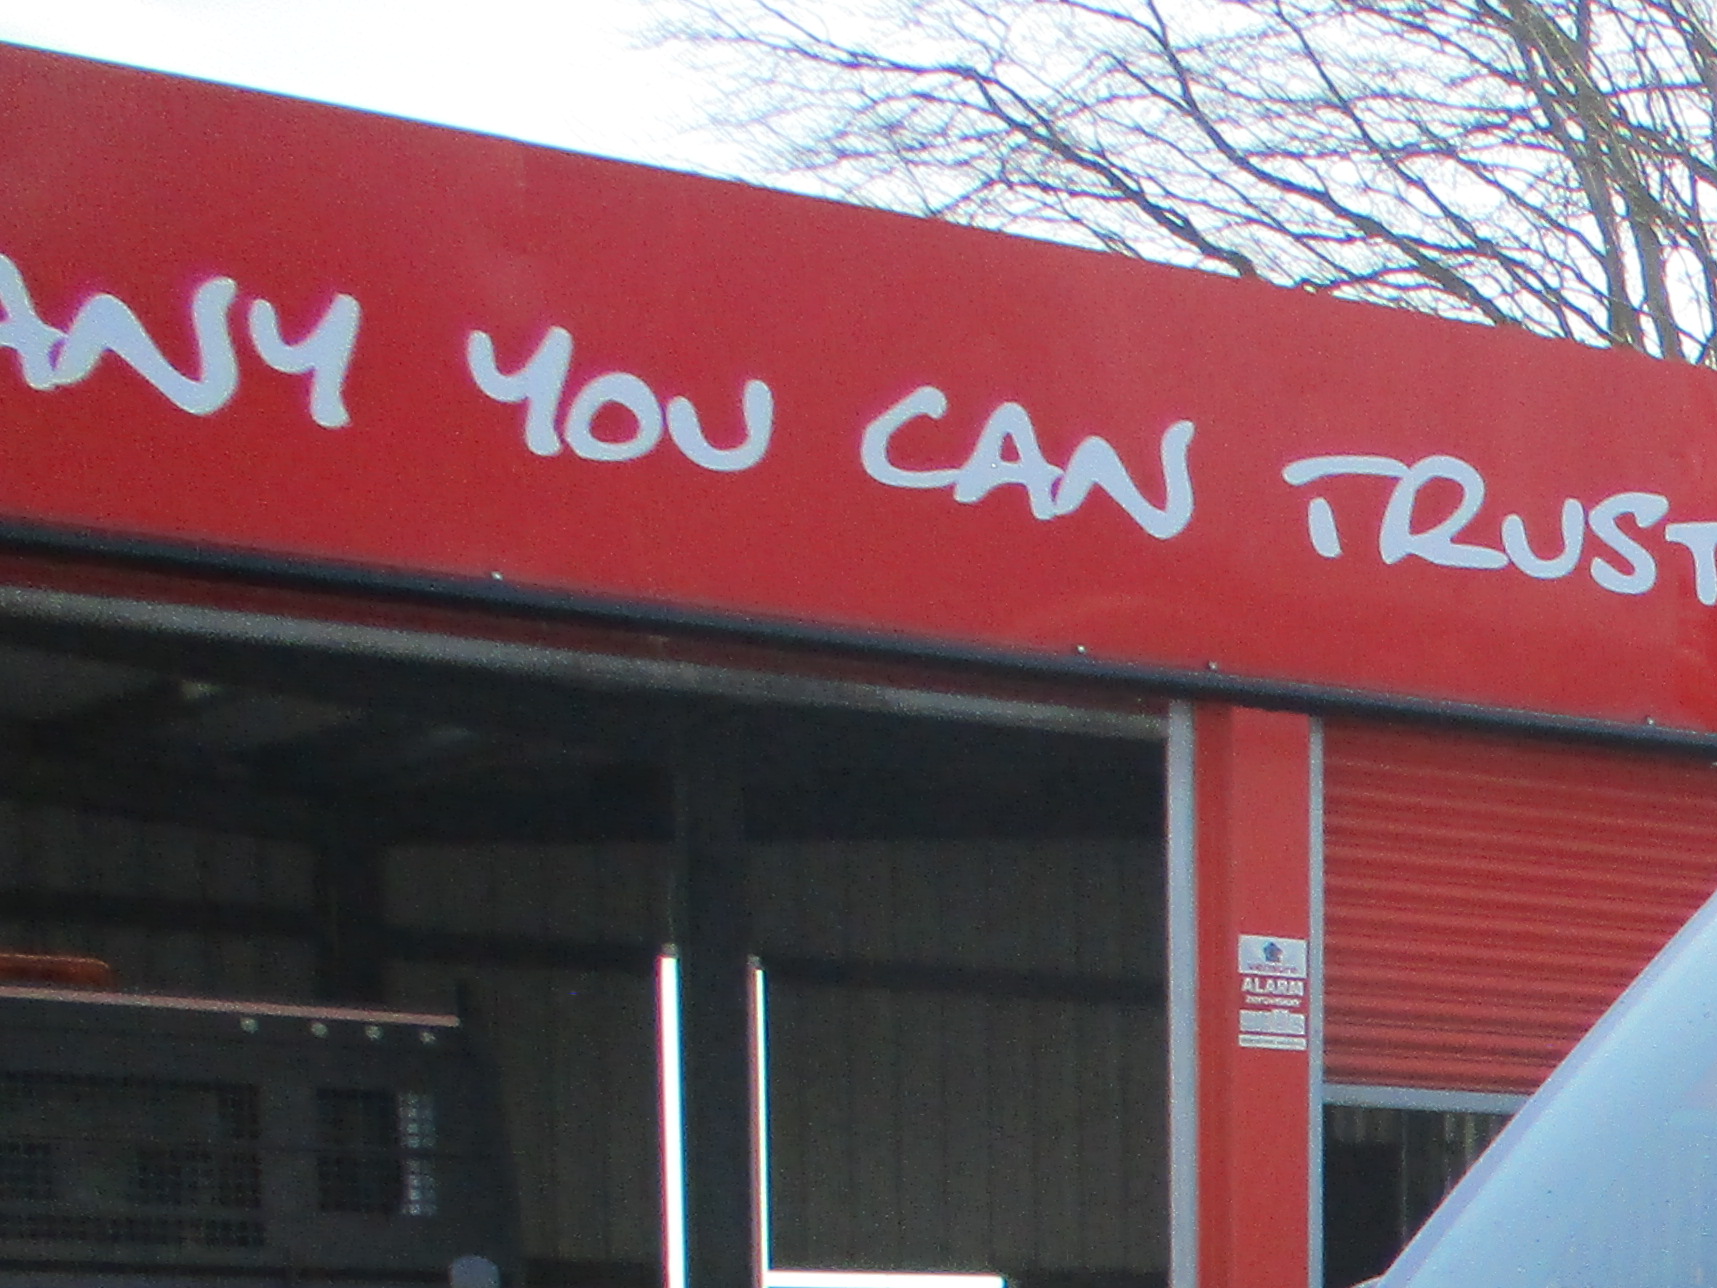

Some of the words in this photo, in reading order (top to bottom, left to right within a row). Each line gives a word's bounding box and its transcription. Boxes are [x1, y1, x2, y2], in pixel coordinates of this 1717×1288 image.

[466, 325, 772, 473] YOU
[860, 386, 1194, 539] CAN
[1242, 977, 1304, 996] ALARM
